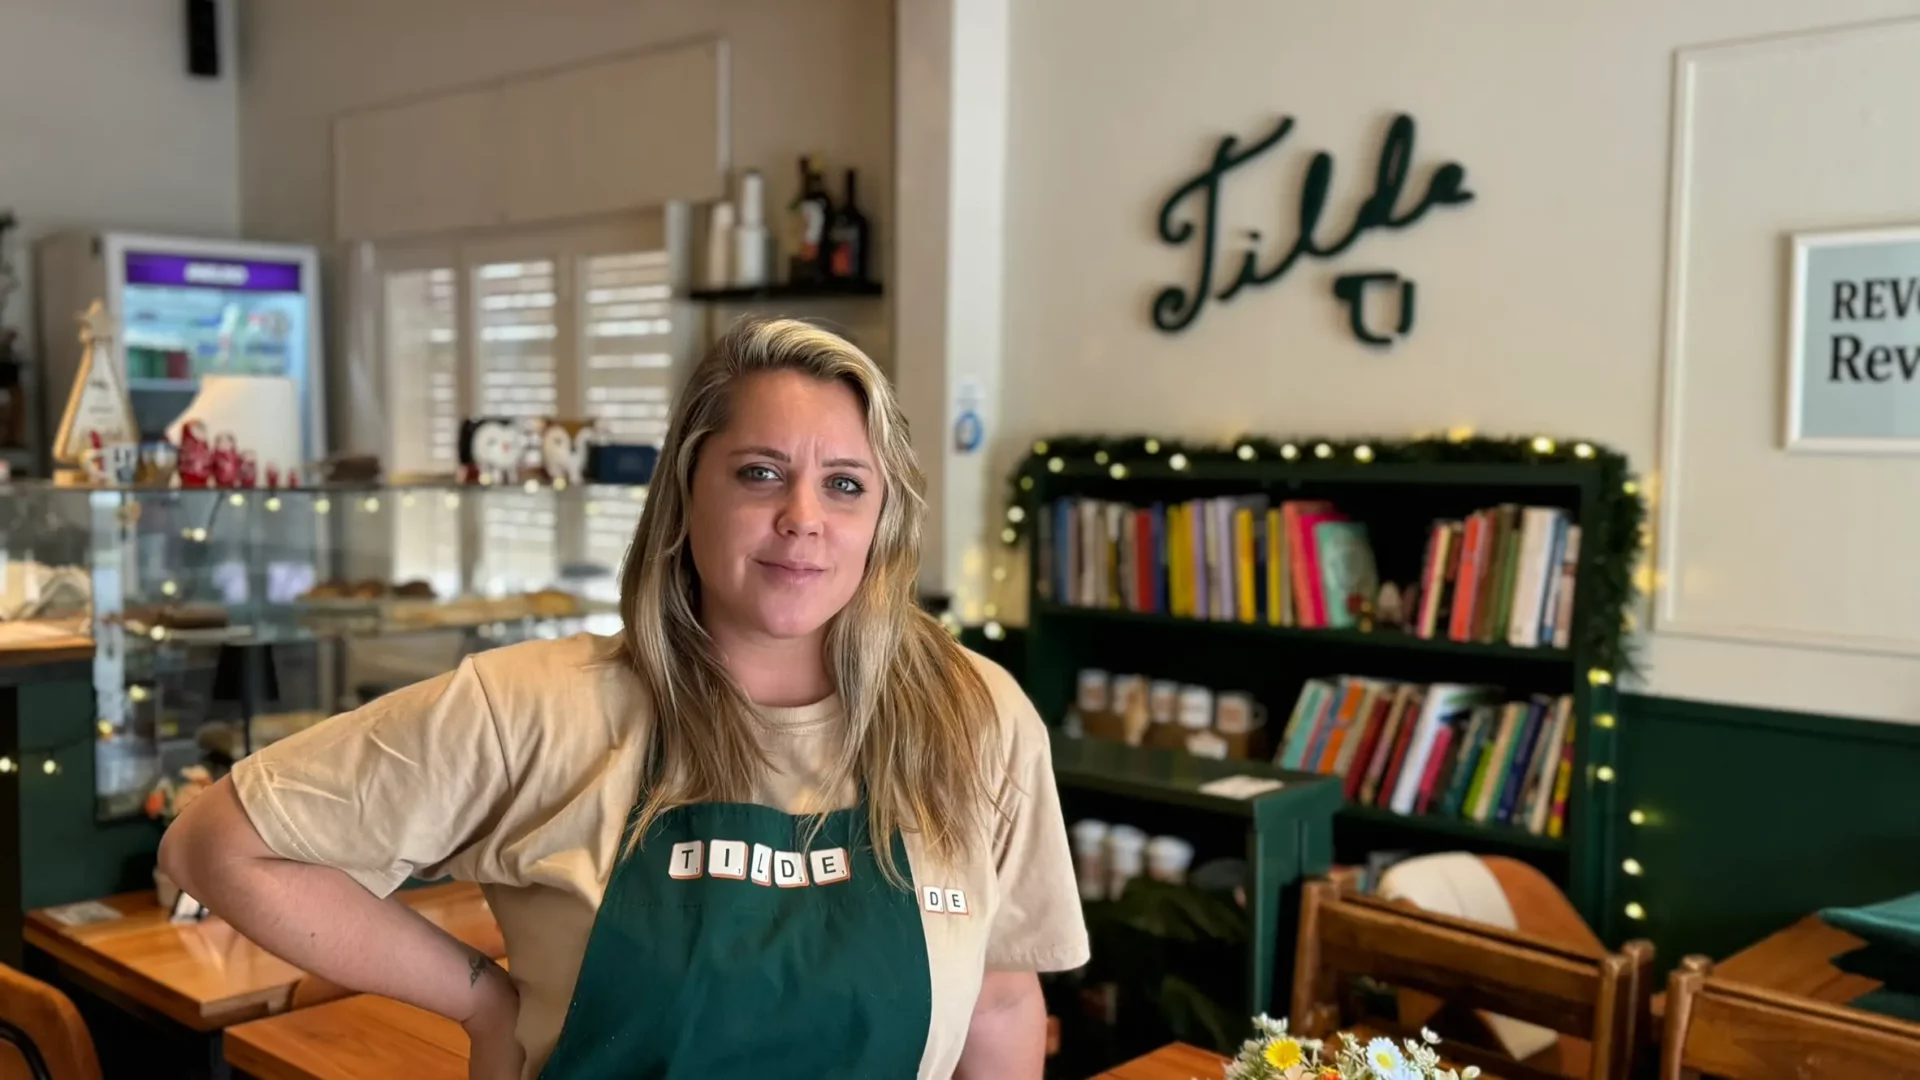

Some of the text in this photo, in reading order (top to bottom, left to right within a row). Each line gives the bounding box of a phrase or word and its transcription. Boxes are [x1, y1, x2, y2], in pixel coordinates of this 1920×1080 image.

[1153, 113, 1474, 333] Tilde
[1831, 276, 1920, 321] REV
[681, 848, 836, 878] TILDE
